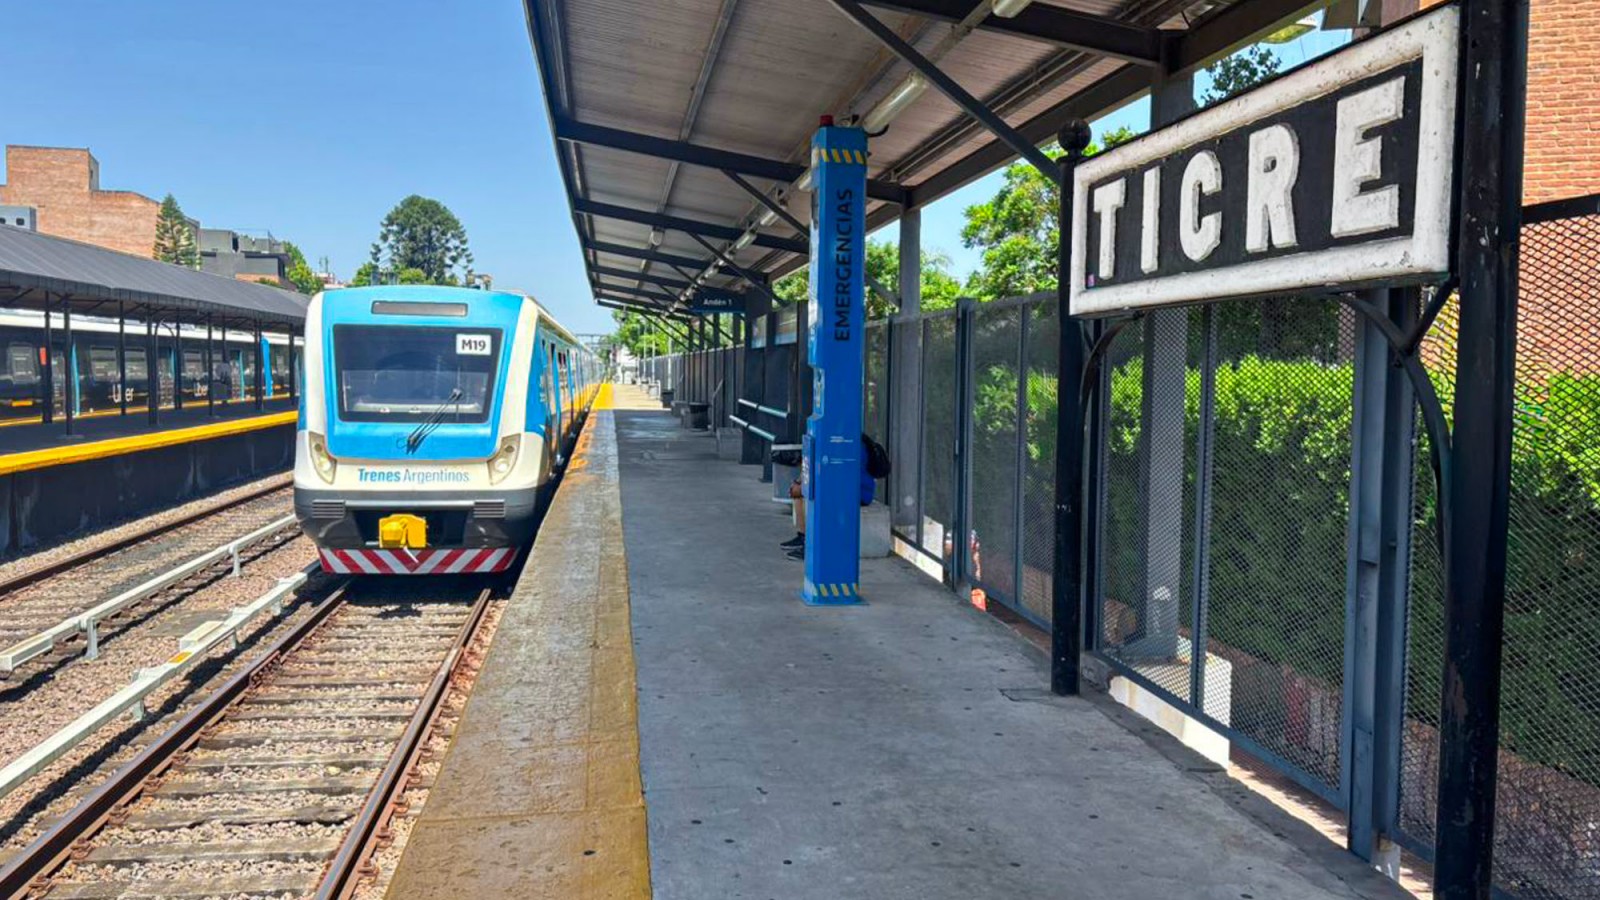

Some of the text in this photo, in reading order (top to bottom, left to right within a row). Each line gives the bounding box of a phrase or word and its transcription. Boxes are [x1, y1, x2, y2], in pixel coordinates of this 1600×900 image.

[834, 188, 853, 342] EMERGENCIAS
[461, 339, 486, 351] M19
[112, 383, 135, 404] Uer
[358, 468, 470, 484] Trenes Argentinos
